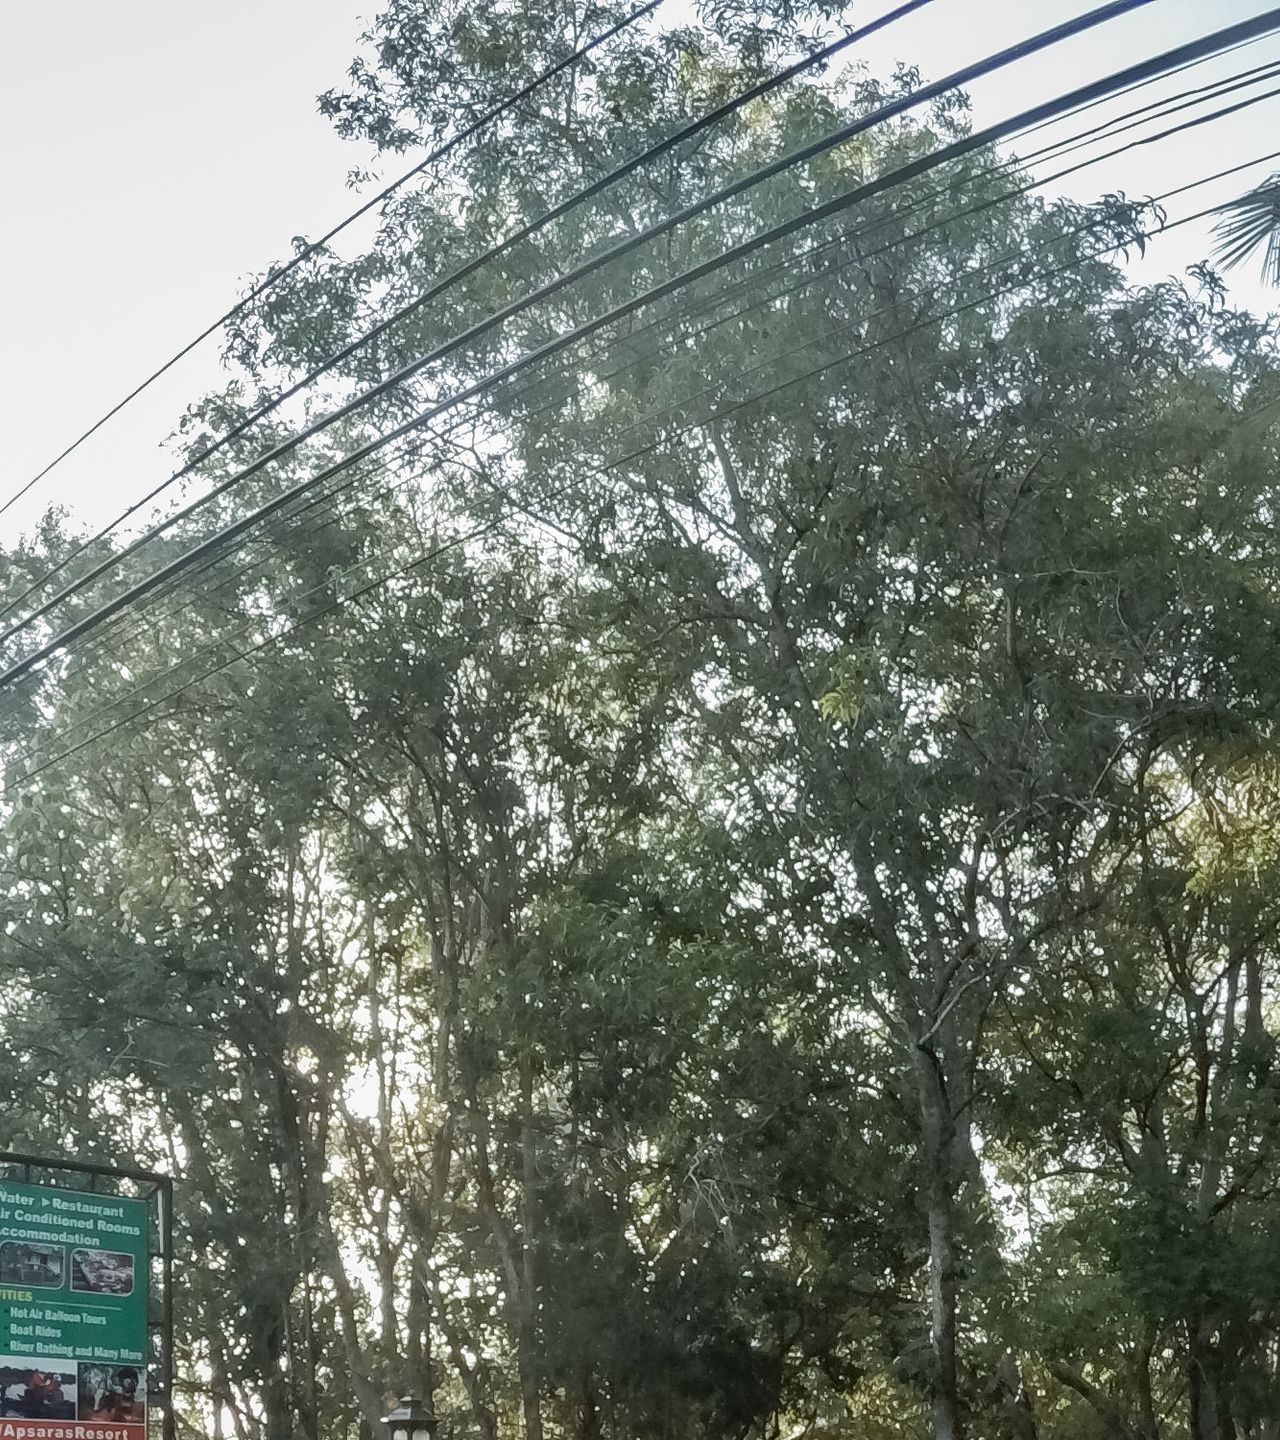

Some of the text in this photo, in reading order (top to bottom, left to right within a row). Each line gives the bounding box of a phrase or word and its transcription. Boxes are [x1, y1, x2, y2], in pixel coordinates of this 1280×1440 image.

[52, 1198, 124, 1217] Restaurant
[14, 1210, 94, 1230] Conditioned
[98, 1220, 140, 1236] Rooms
[10, 1306, 107, 1325] Hot Air Balloon Tours
[10, 1323, 62, 1338] Boat Rides
[10, 1341, 142, 1360] River Bathing and Many More
